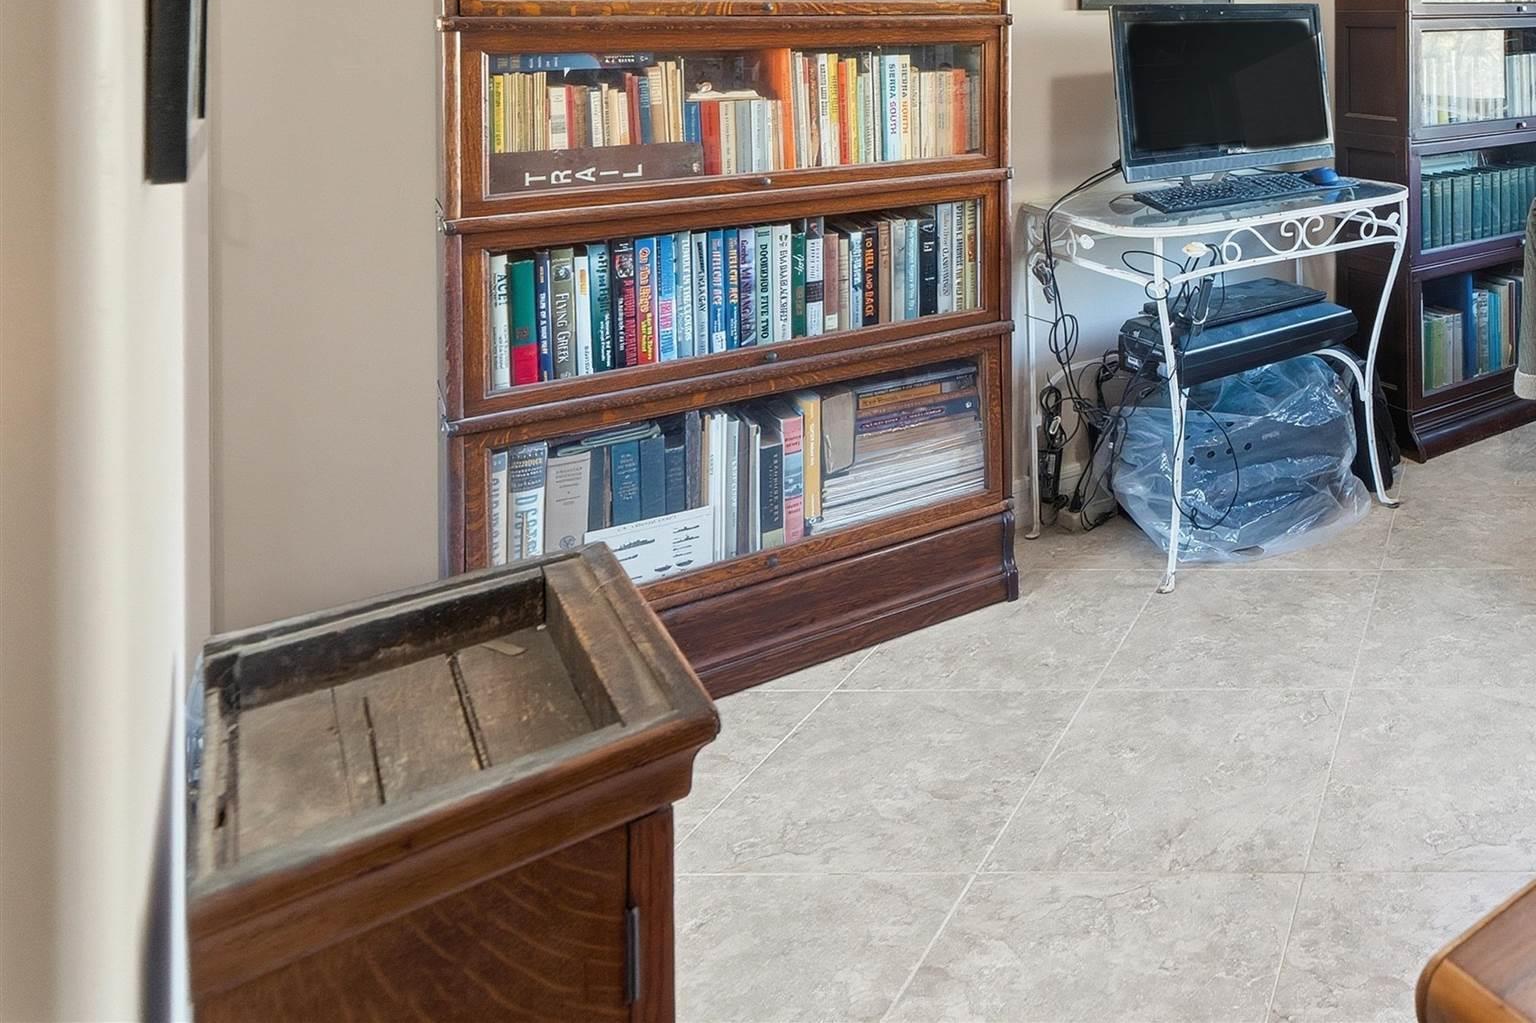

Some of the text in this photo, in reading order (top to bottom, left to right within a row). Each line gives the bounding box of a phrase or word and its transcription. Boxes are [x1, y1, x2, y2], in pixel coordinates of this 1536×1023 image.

[888, 63, 897, 99] SIERRA
[524, 163, 643, 187] TRAIL
[712, 251, 722, 305] HELLCAT ACE
[728, 250, 738, 304] HELLCAT ACE
[865, 237, 874, 316] TO HELL AND BACK
[698, 295, 706, 312] GAY
[760, 295, 769, 318] FIVE
[555, 292, 571, 364] FLYING GREEK
[625, 319, 637, 365] AMERICAN
[761, 319, 769, 339] TWO
